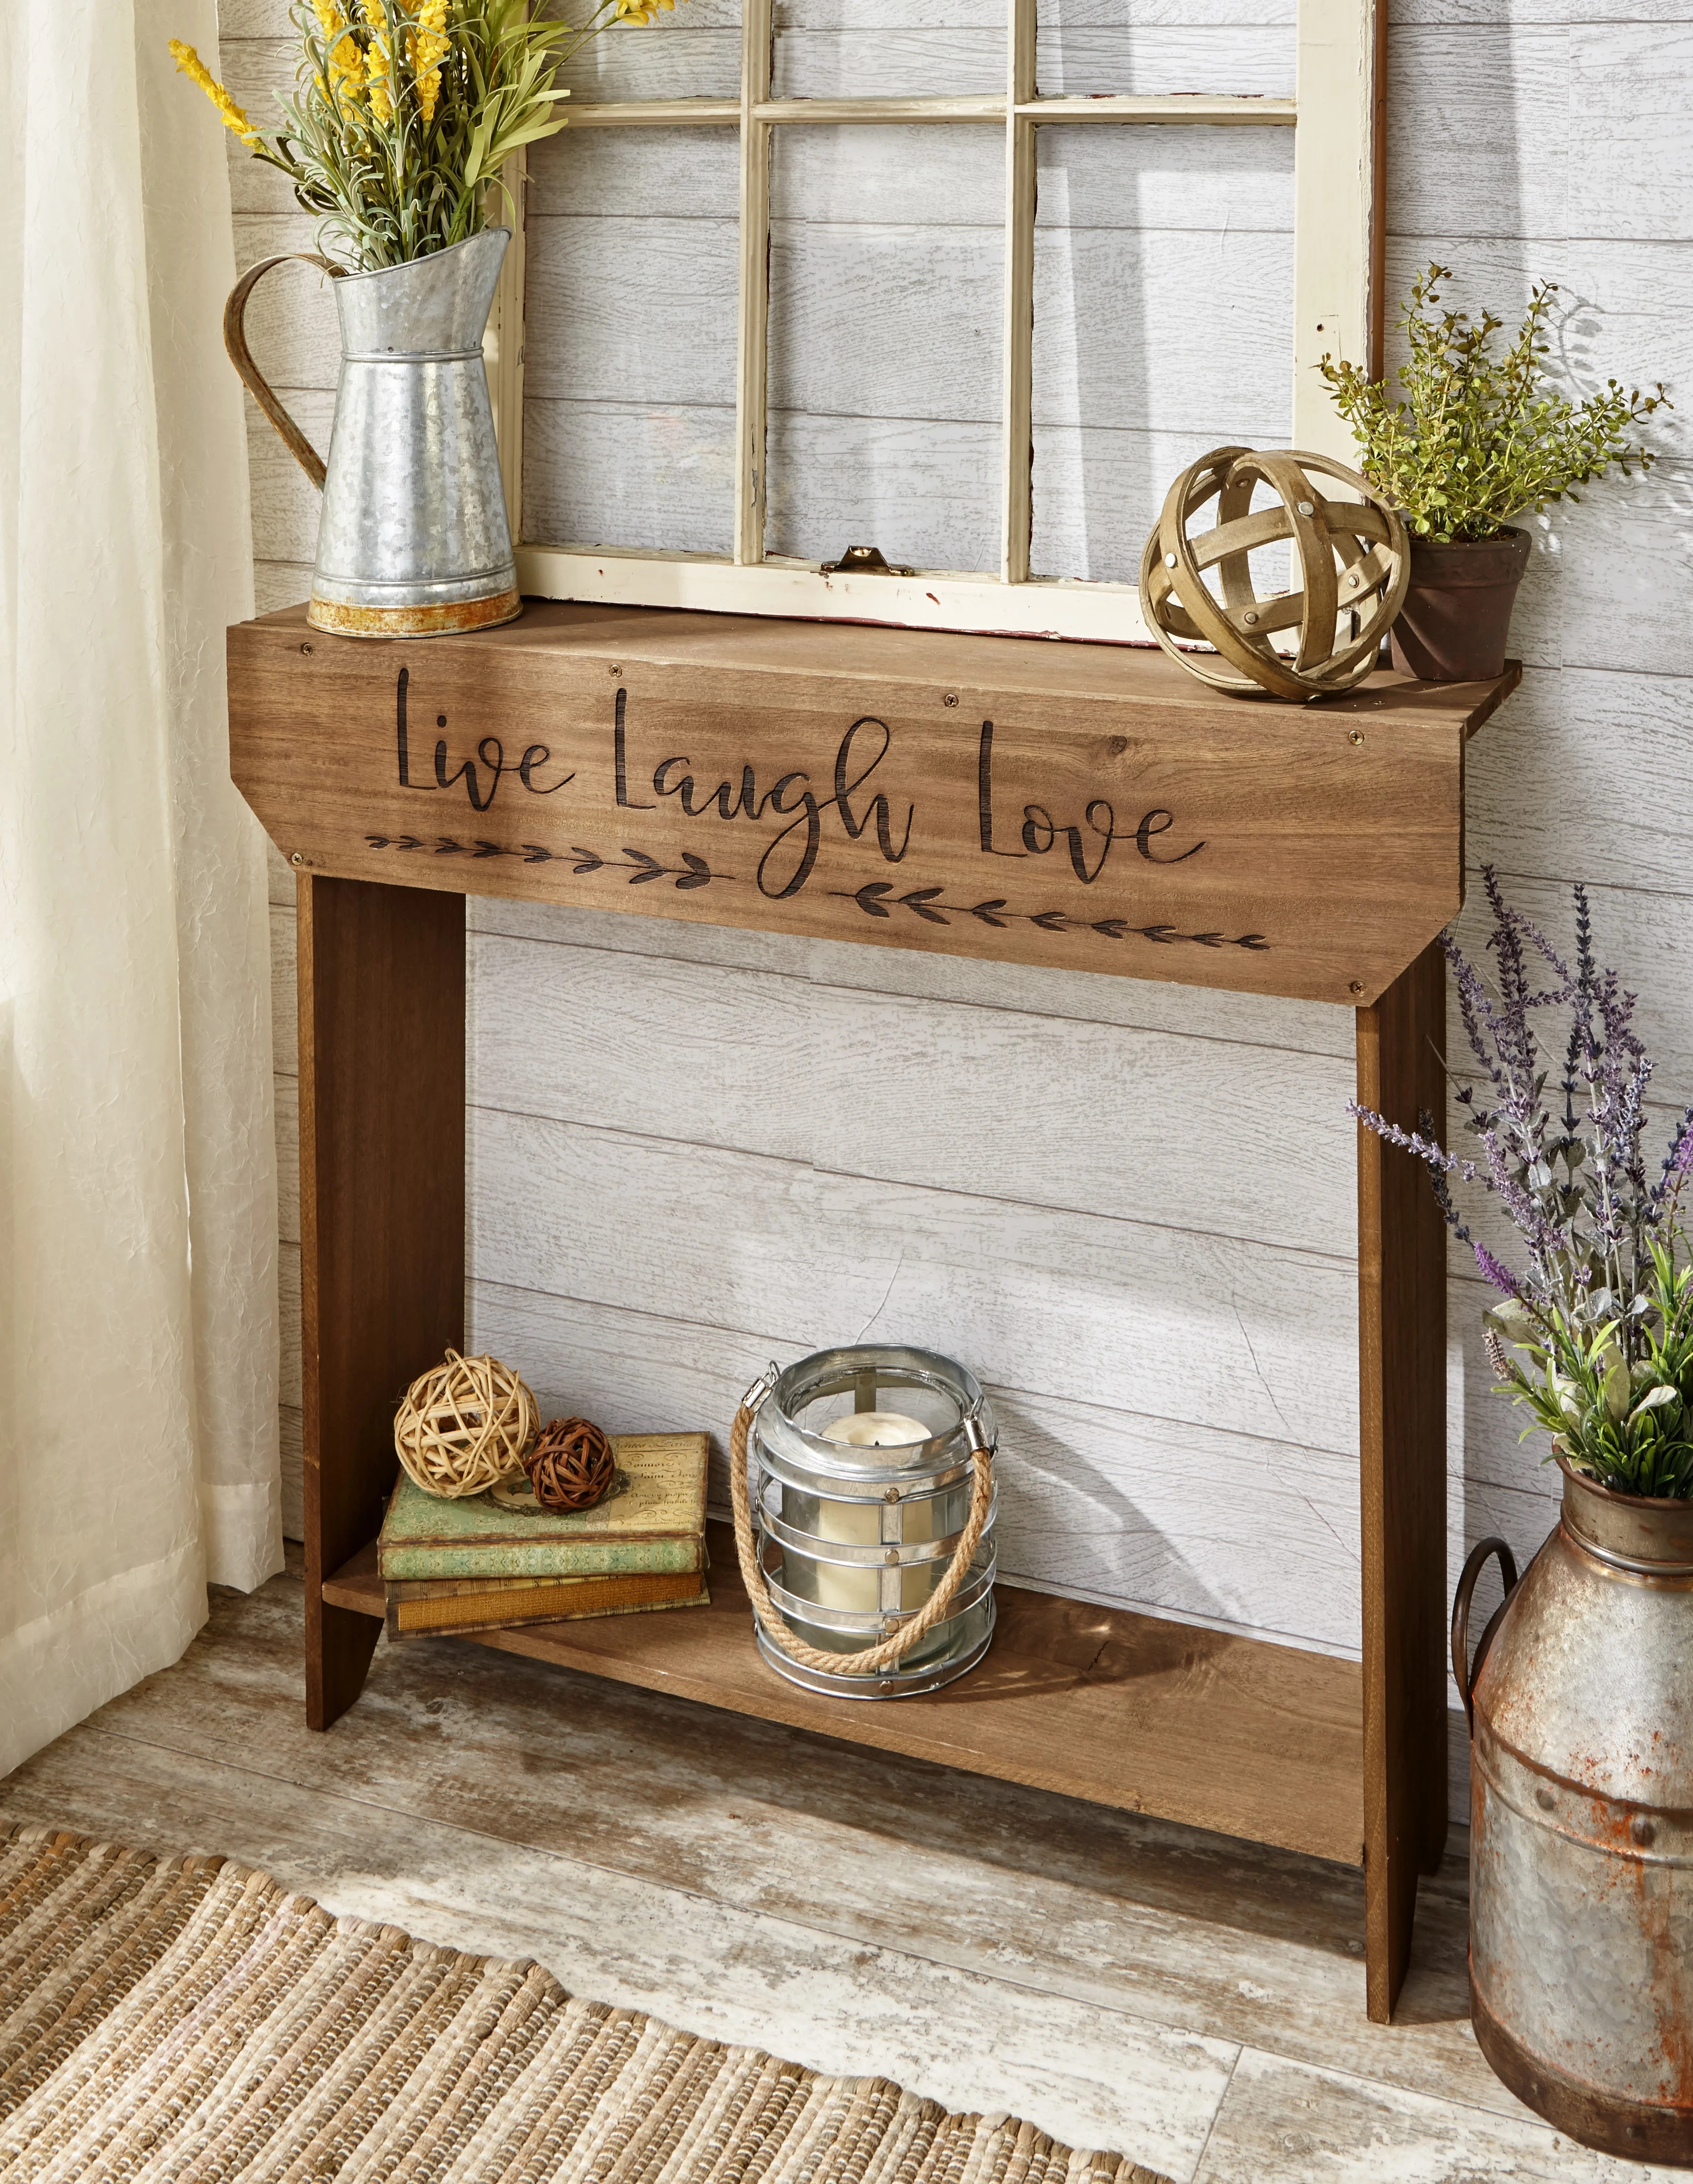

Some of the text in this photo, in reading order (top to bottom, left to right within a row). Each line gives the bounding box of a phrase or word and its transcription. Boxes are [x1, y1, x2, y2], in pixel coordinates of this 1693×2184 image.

[397, 667, 1207, 899] Live Laugh Love
